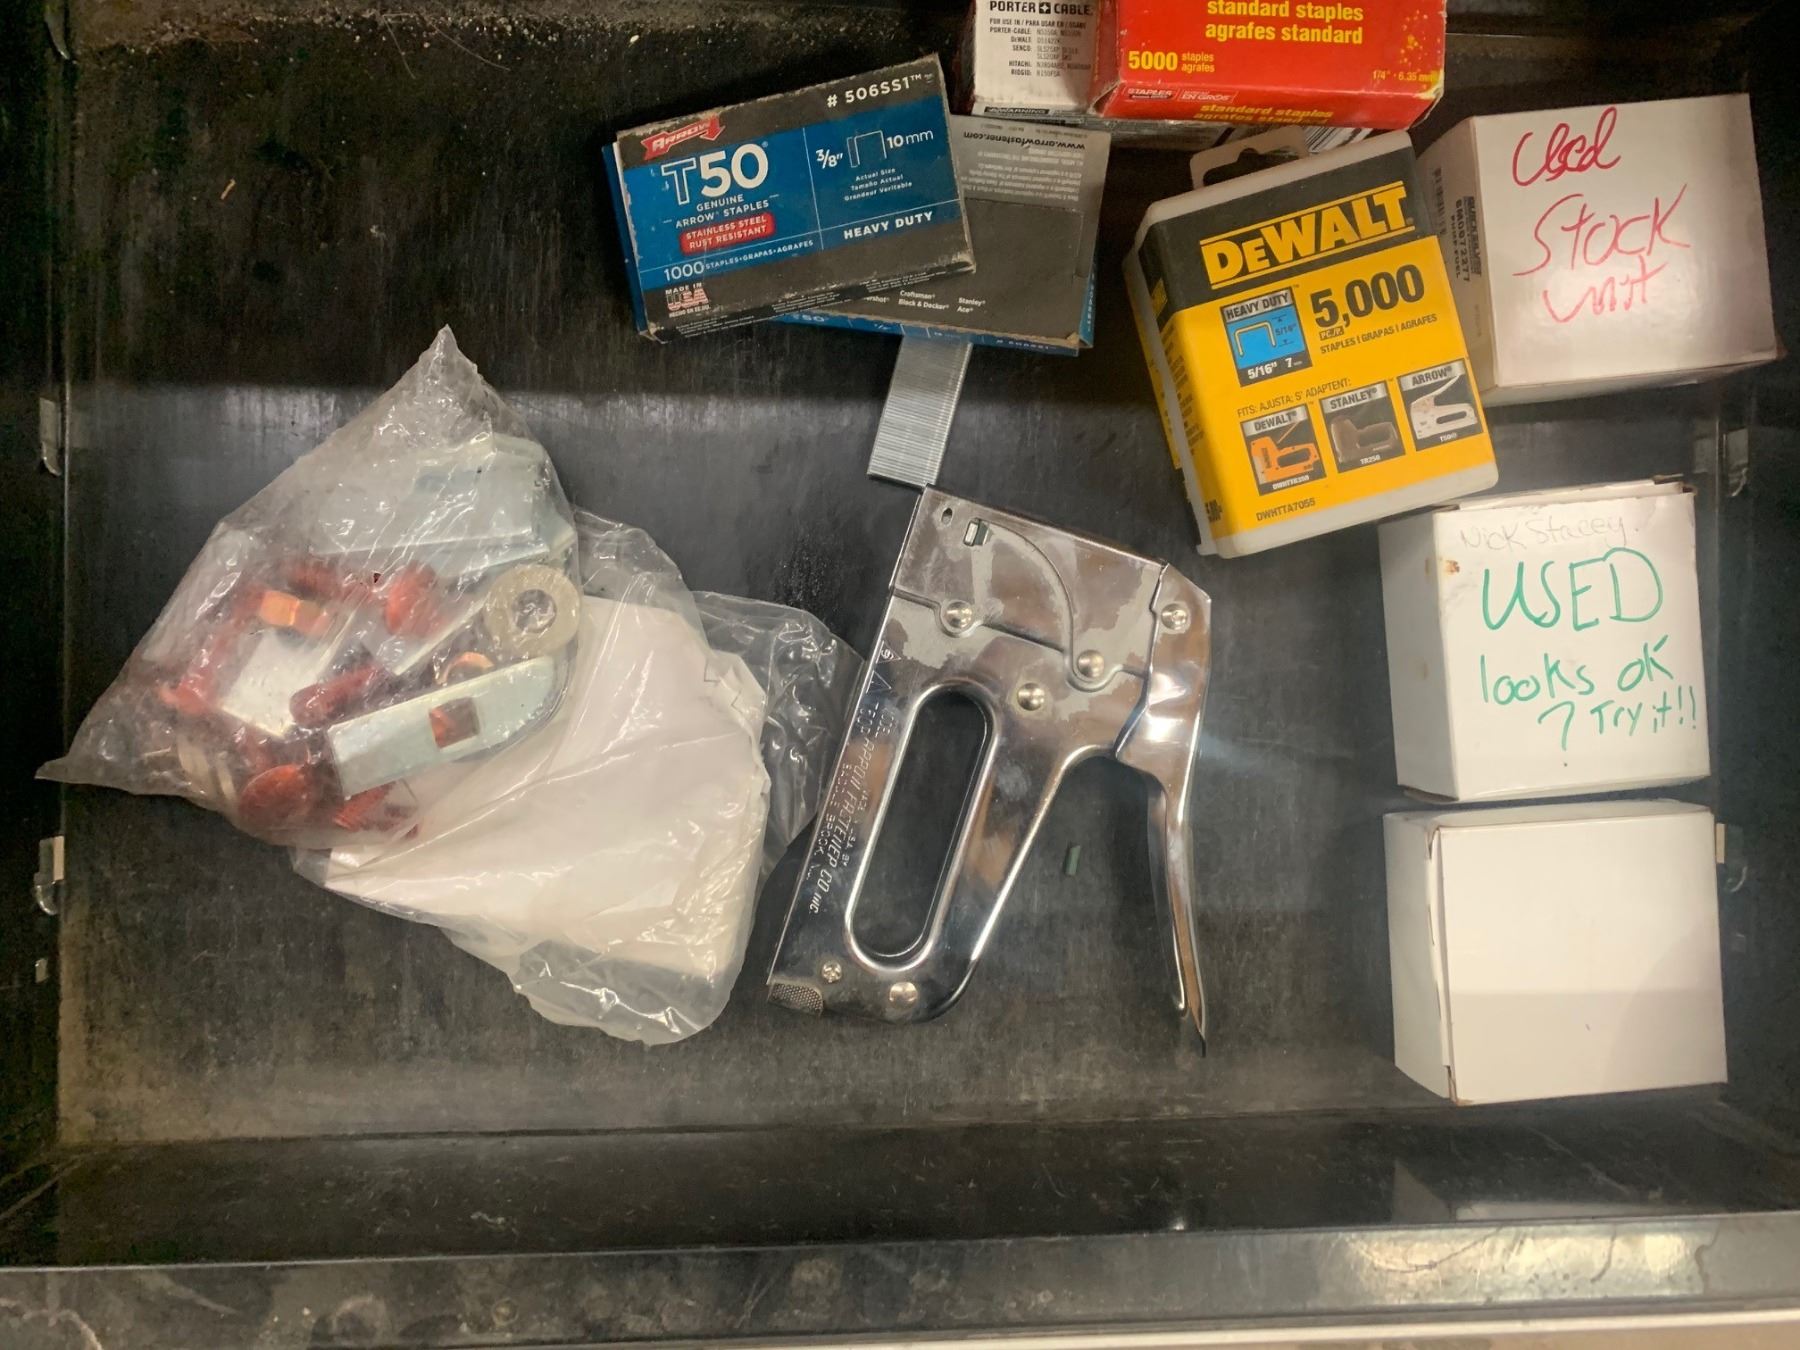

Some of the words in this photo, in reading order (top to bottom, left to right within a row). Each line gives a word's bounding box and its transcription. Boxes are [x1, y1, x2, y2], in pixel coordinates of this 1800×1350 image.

[989, 0, 1036, 13] PORTER
[1054, 4, 1090, 16] CABLE
[1207, 0, 1289, 16] standard
[1295, 1, 1364, 22] staples
[1205, 20, 1276, 43] agrafes
[1281, 22, 1363, 45] standard
[1128, 50, 1178, 71] 5000
[1181, 51, 1214, 63] staples
[1181, 62, 1215, 74] agrafes
[827, 94, 838, 108] #
[855, 171, 879, 182] Actual
[880, 167, 896, 177] Size
[879, 174, 904, 185] Actual
[696, 193, 745, 213] GENUINE
[844, 190, 878, 201] Grandeur
[723, 199, 770, 218] STAPLES
[685, 221, 736, 240] STAINLESS
[738, 215, 768, 229] STEEL
[844, 221, 890, 240] HEAVY
[895, 211, 934, 228] DUTY
[689, 238, 714, 250] RUST
[715, 225, 767, 244] RESISTANT
[663, 260, 705, 282] 1000
[666, 288, 709, 312] USA
[1226, 303, 1260, 320] HEAVY
[1262, 292, 1290, 308] DUTY
[1310, 264, 1425, 330] 5,000
[1320, 337, 1356, 354] STAPLES
[1361, 325, 1394, 343] GRAPAS
[1400, 313, 1438, 332] AGRAFES
[1247, 362, 1278, 379] 5/16"
[1237, 406, 1257, 418] FITS:
[1305, 379, 1351, 400] ADAPTENT:
[1256, 498, 1316, 521] DWHTTA7055
[1482, 547, 1663, 631] USED
[1481, 653, 1595, 705] looks
